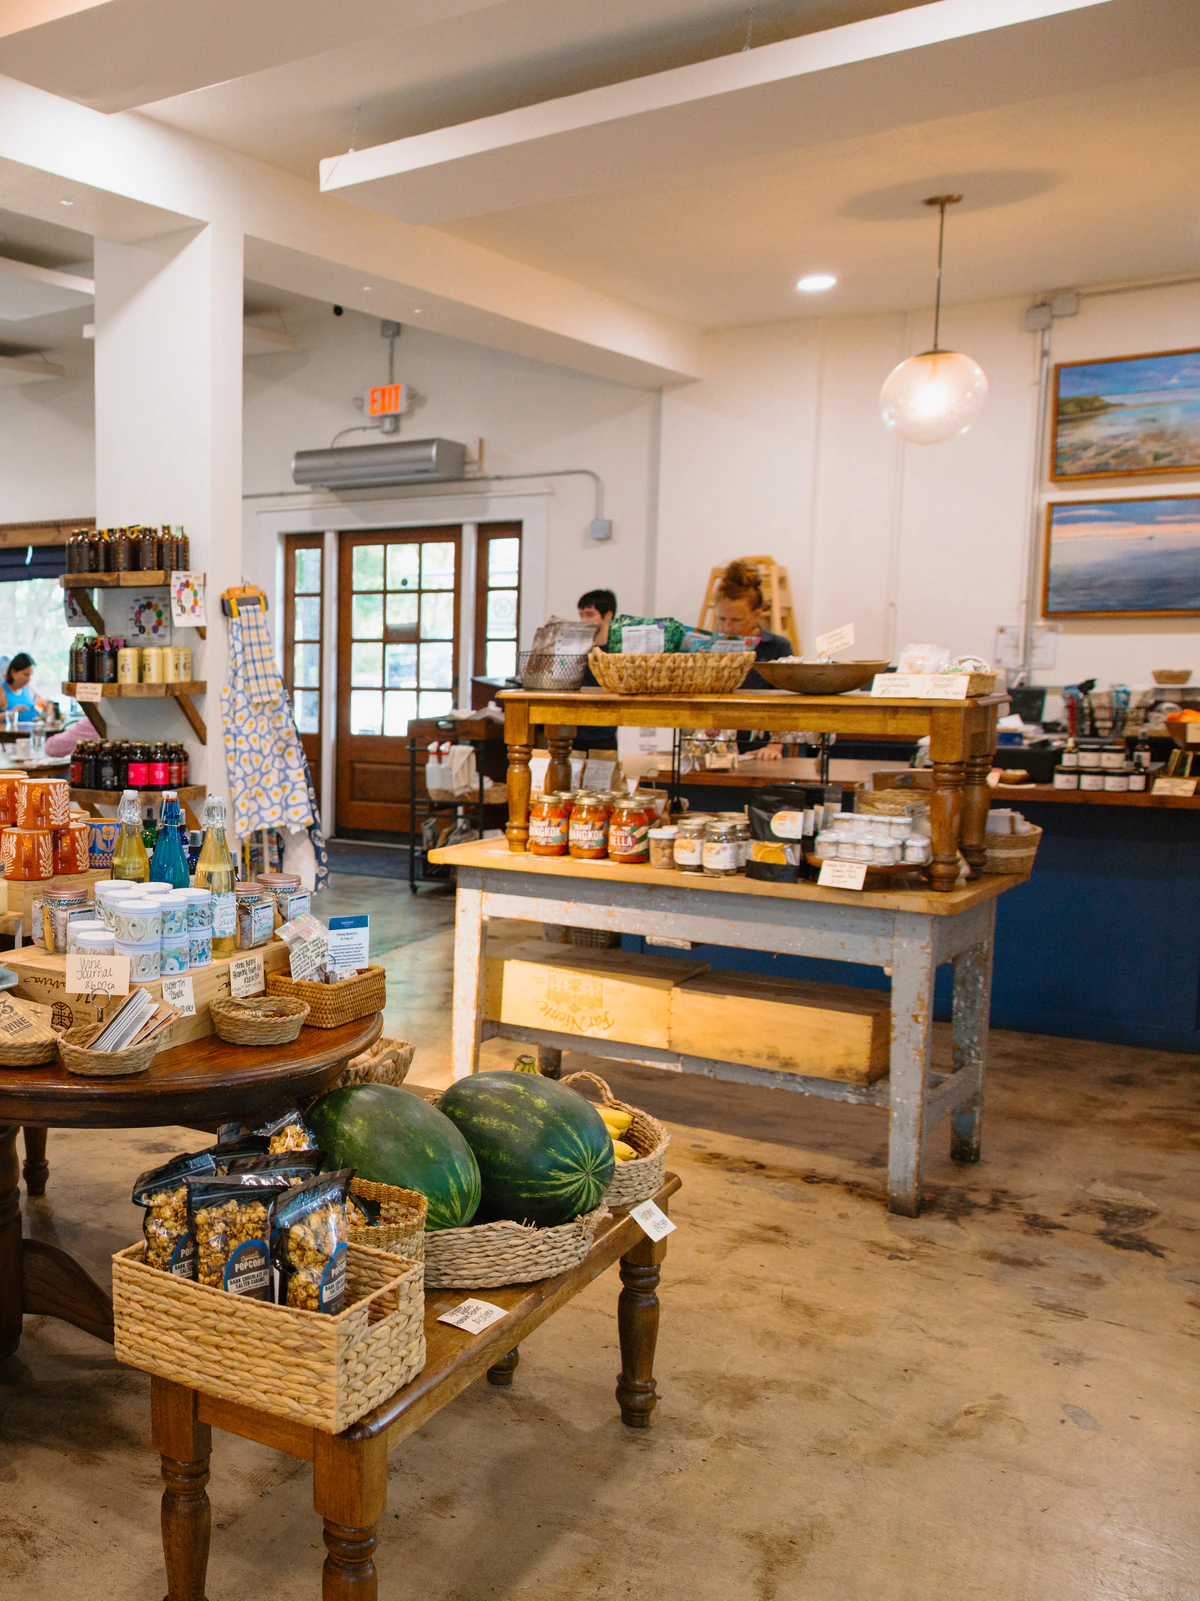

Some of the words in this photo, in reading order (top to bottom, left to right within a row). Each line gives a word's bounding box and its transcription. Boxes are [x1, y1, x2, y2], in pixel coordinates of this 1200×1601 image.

[370, 384, 402, 416] EXIT
[79, 956, 102, 969] Wine
[76, 967, 113, 980] Journal
[0, 1016, 31, 1033] WINE
[234, 1257, 266, 1273] POPCORN
[229, 1276, 242, 1286] DARK
[242, 1271, 263, 1283] CHOCOLATE
[235, 1280, 251, 1290] SALTED
